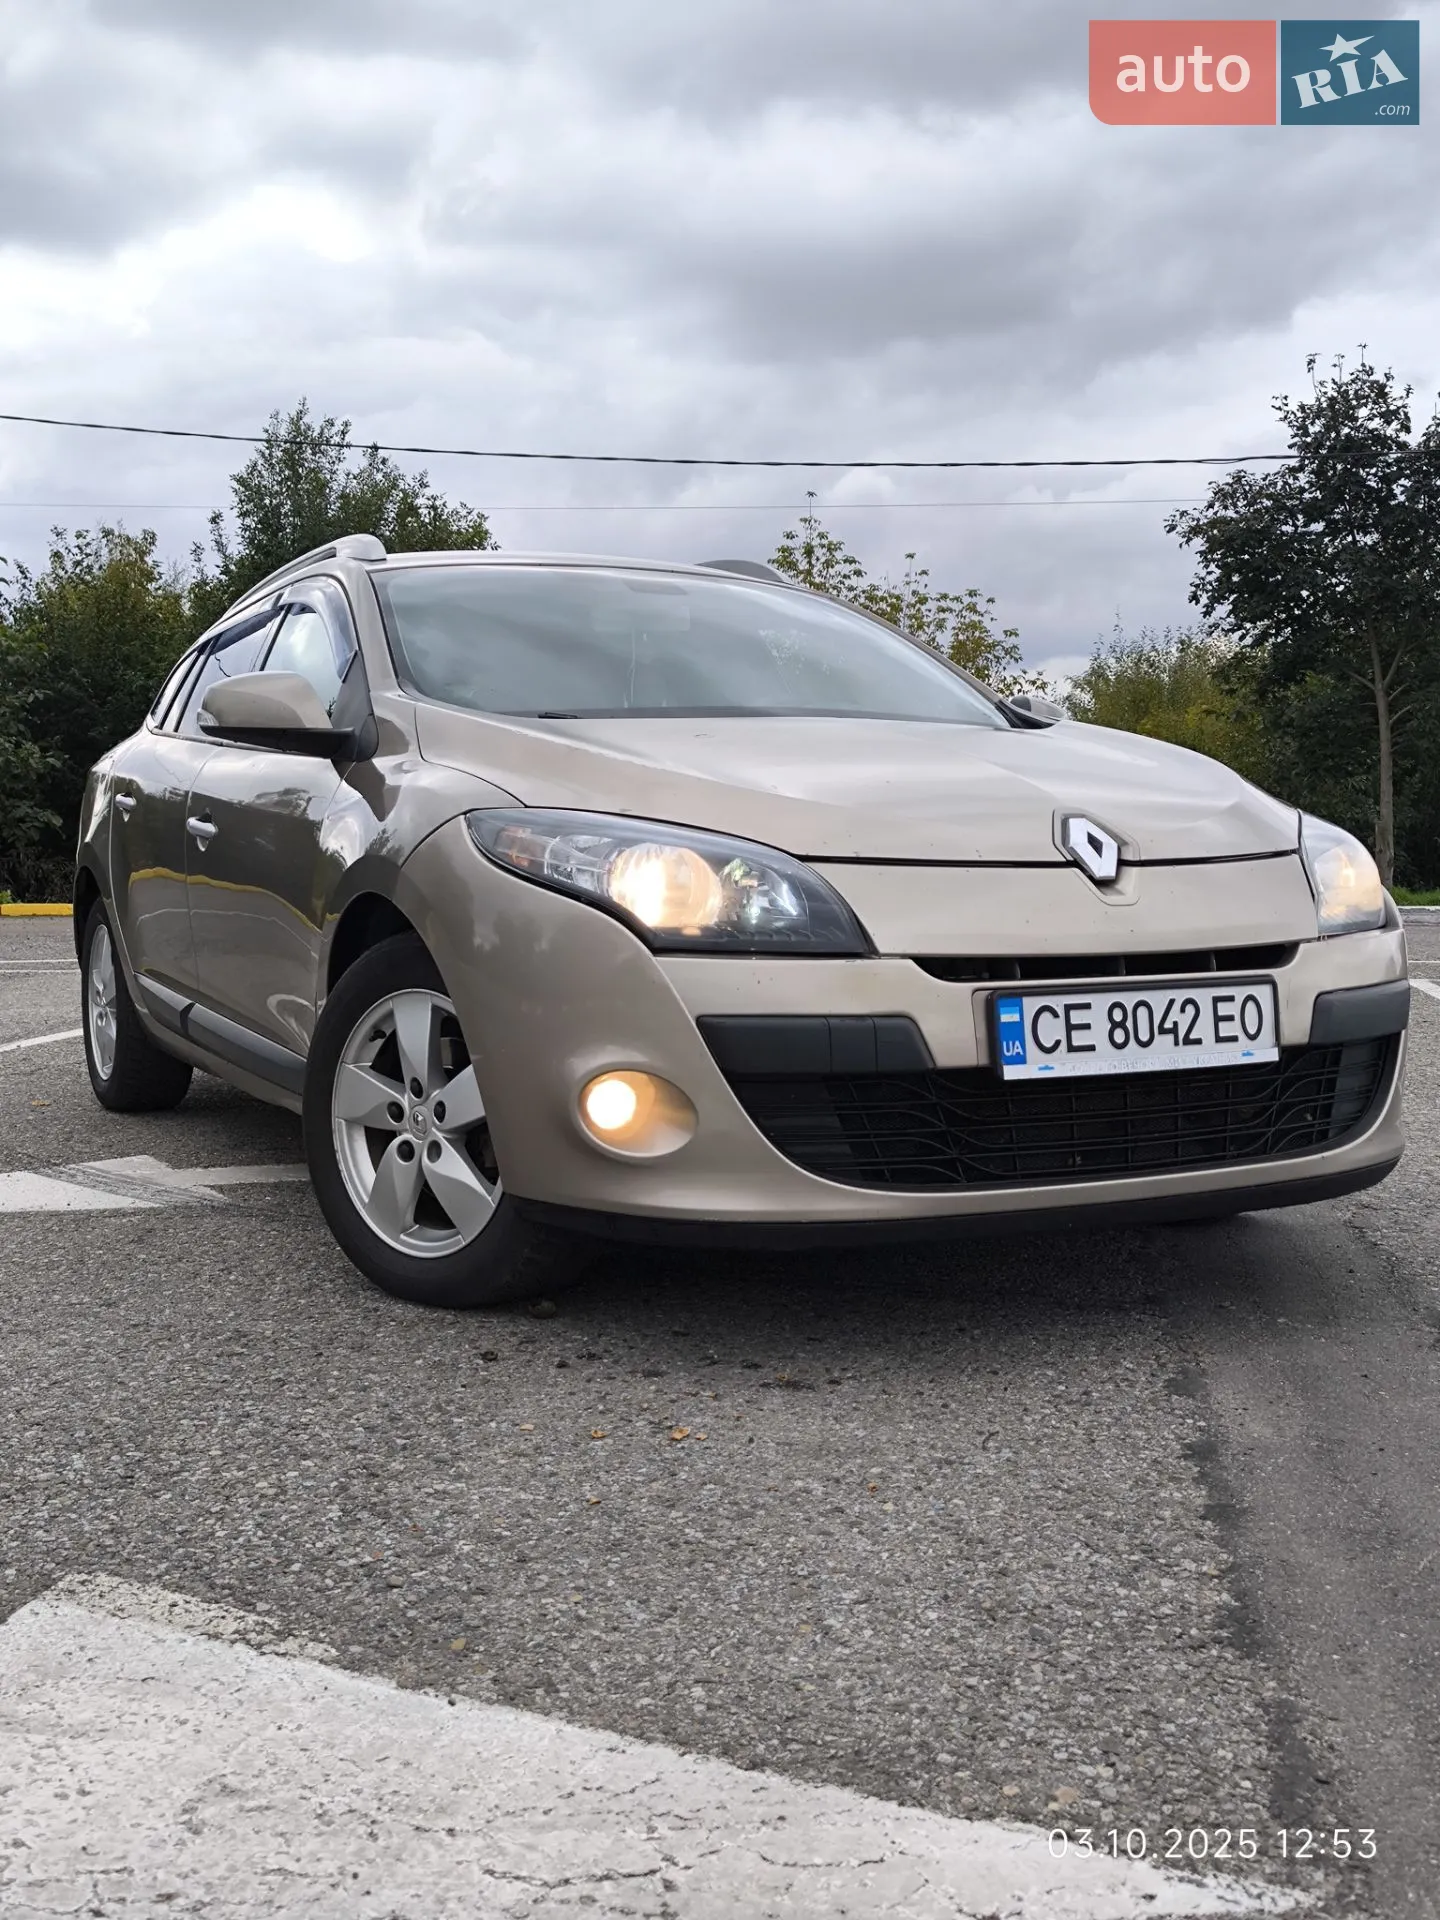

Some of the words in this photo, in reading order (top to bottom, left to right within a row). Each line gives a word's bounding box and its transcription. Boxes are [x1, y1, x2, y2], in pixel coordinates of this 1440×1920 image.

[1031, 1001, 1097, 1055] CE
[1107, 997, 1203, 1050] 8042
[1212, 993, 1264, 1043] EO
[1002, 1040, 1024, 1056] UA
